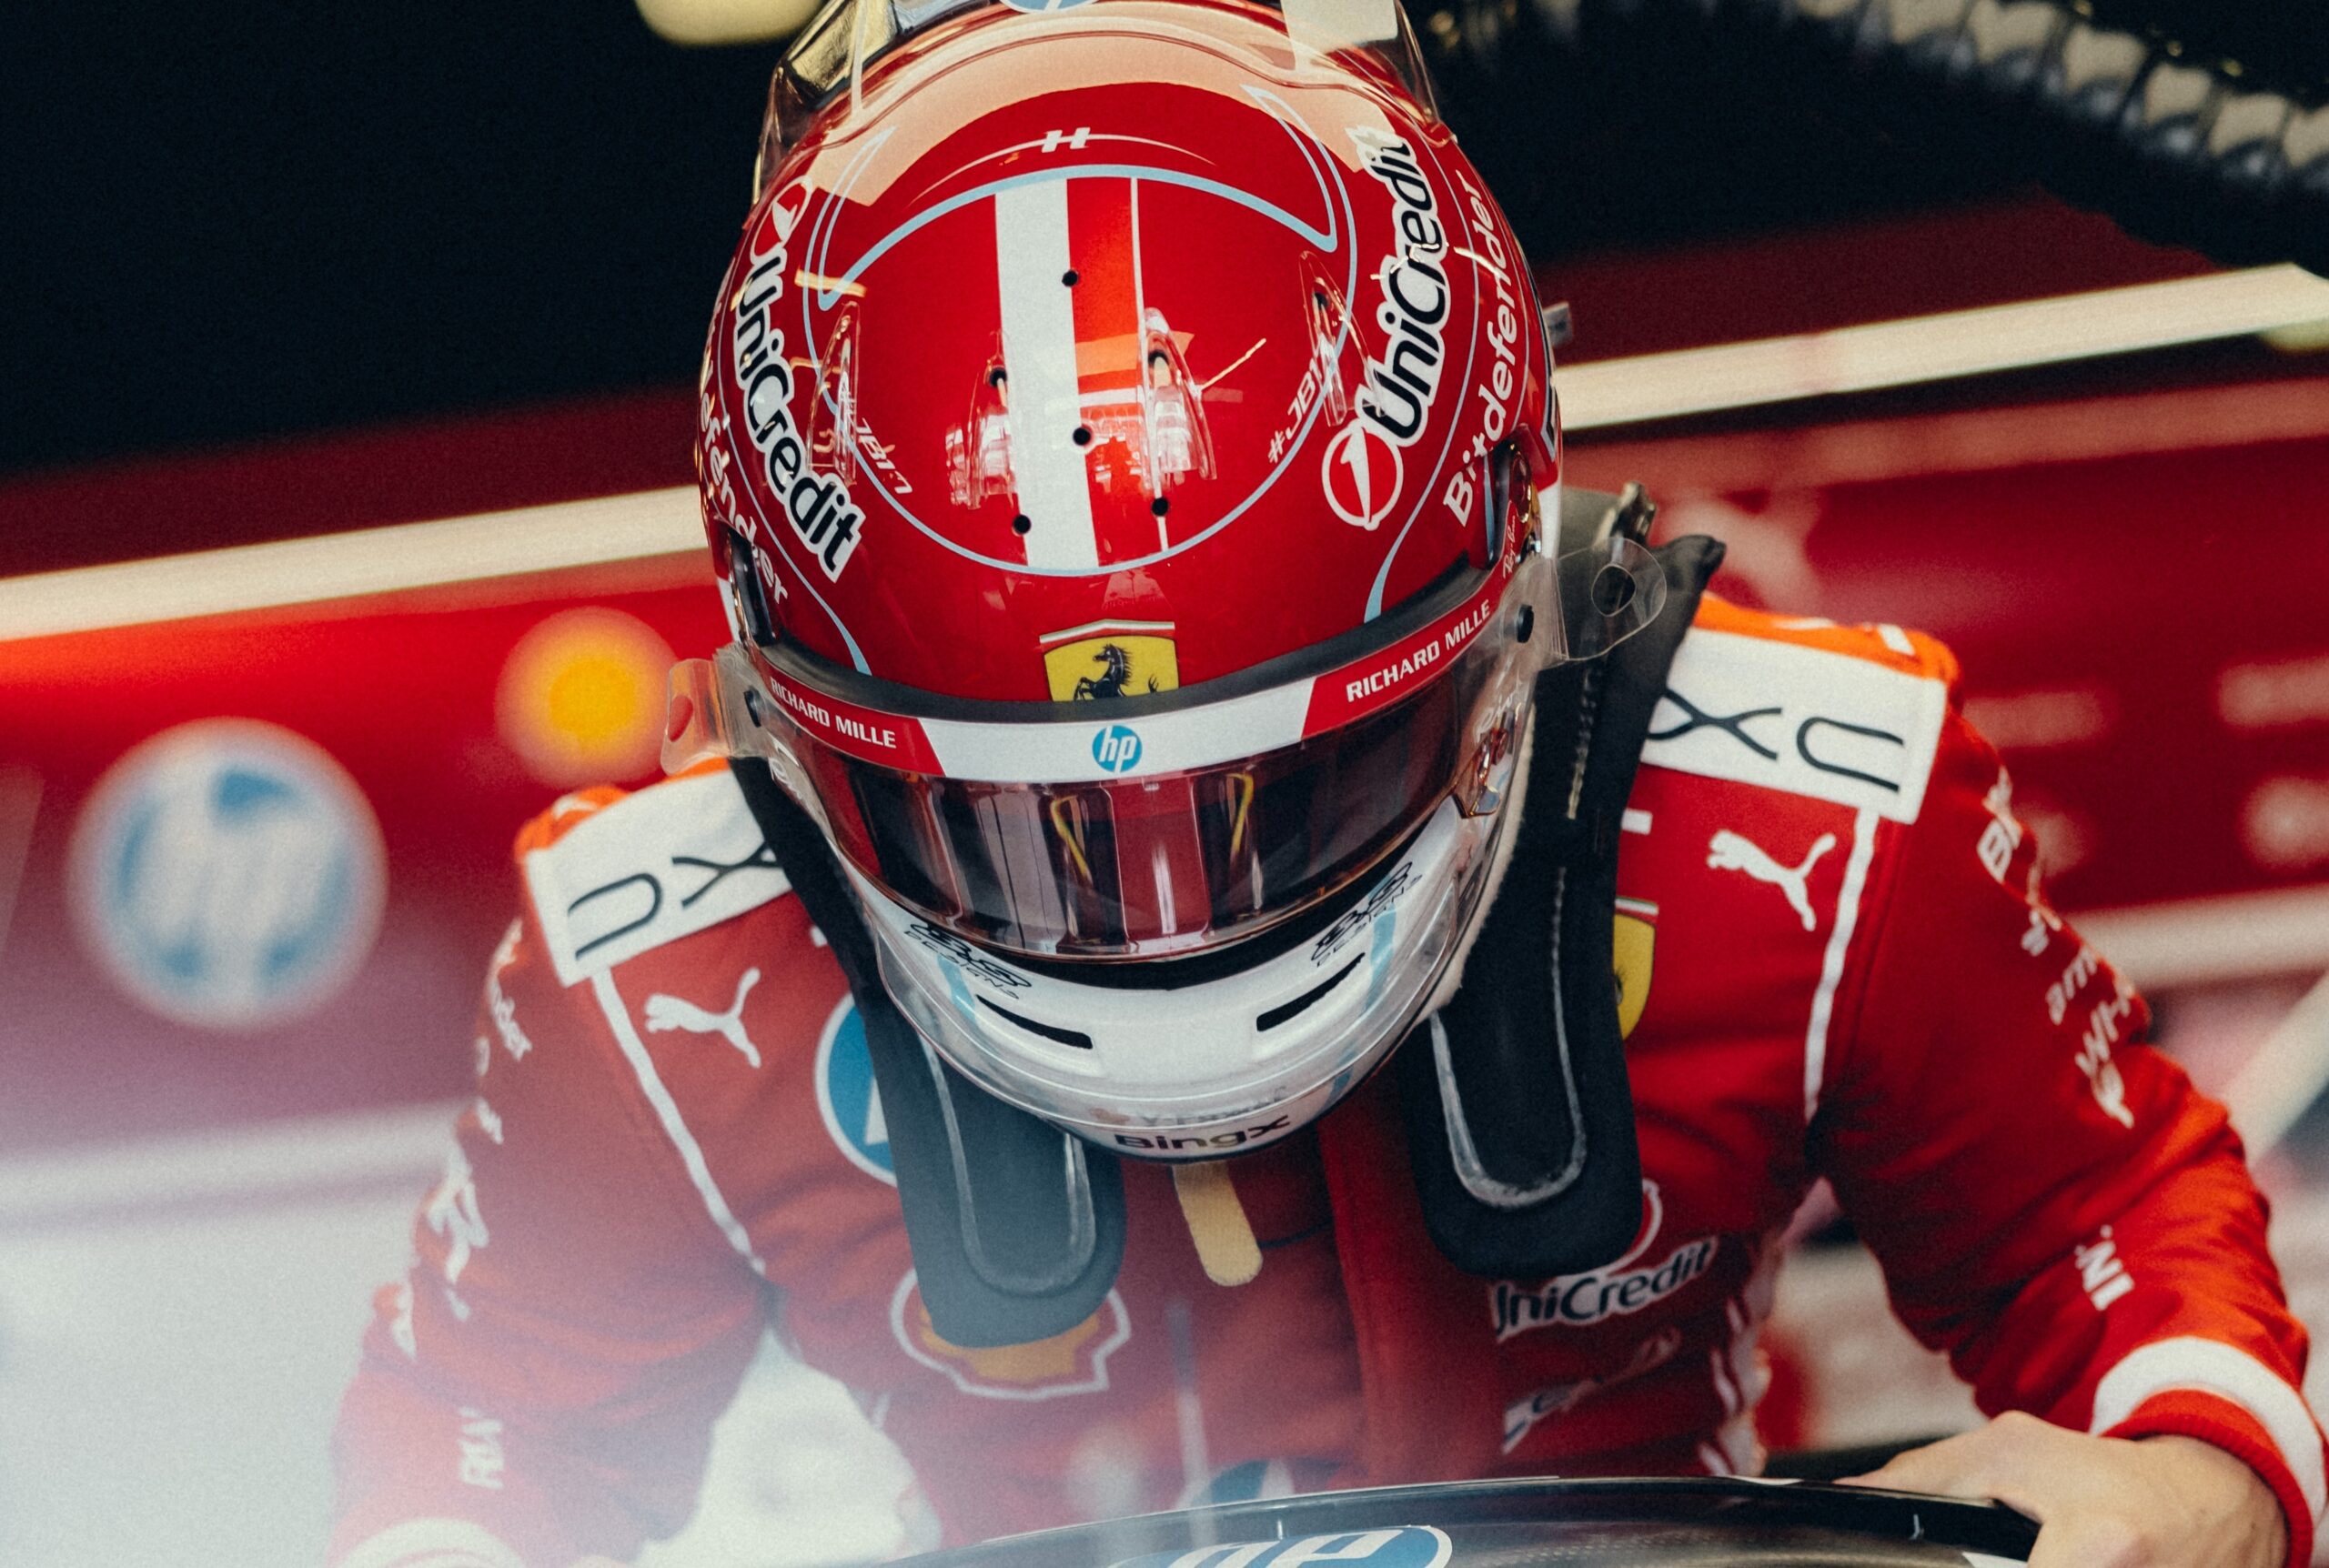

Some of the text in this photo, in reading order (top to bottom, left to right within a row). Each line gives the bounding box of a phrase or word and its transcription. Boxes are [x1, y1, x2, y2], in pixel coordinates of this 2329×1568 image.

[1352, 128, 1450, 441] UniCredit
[1443, 168, 1517, 527] Bitdefender
[736, 253, 862, 575] UniCredit
[770, 676, 897, 749] RICHARD MILLE
[1097, 726, 1137, 773] hp
[1346, 598, 1491, 703] RICHARD MILLE
